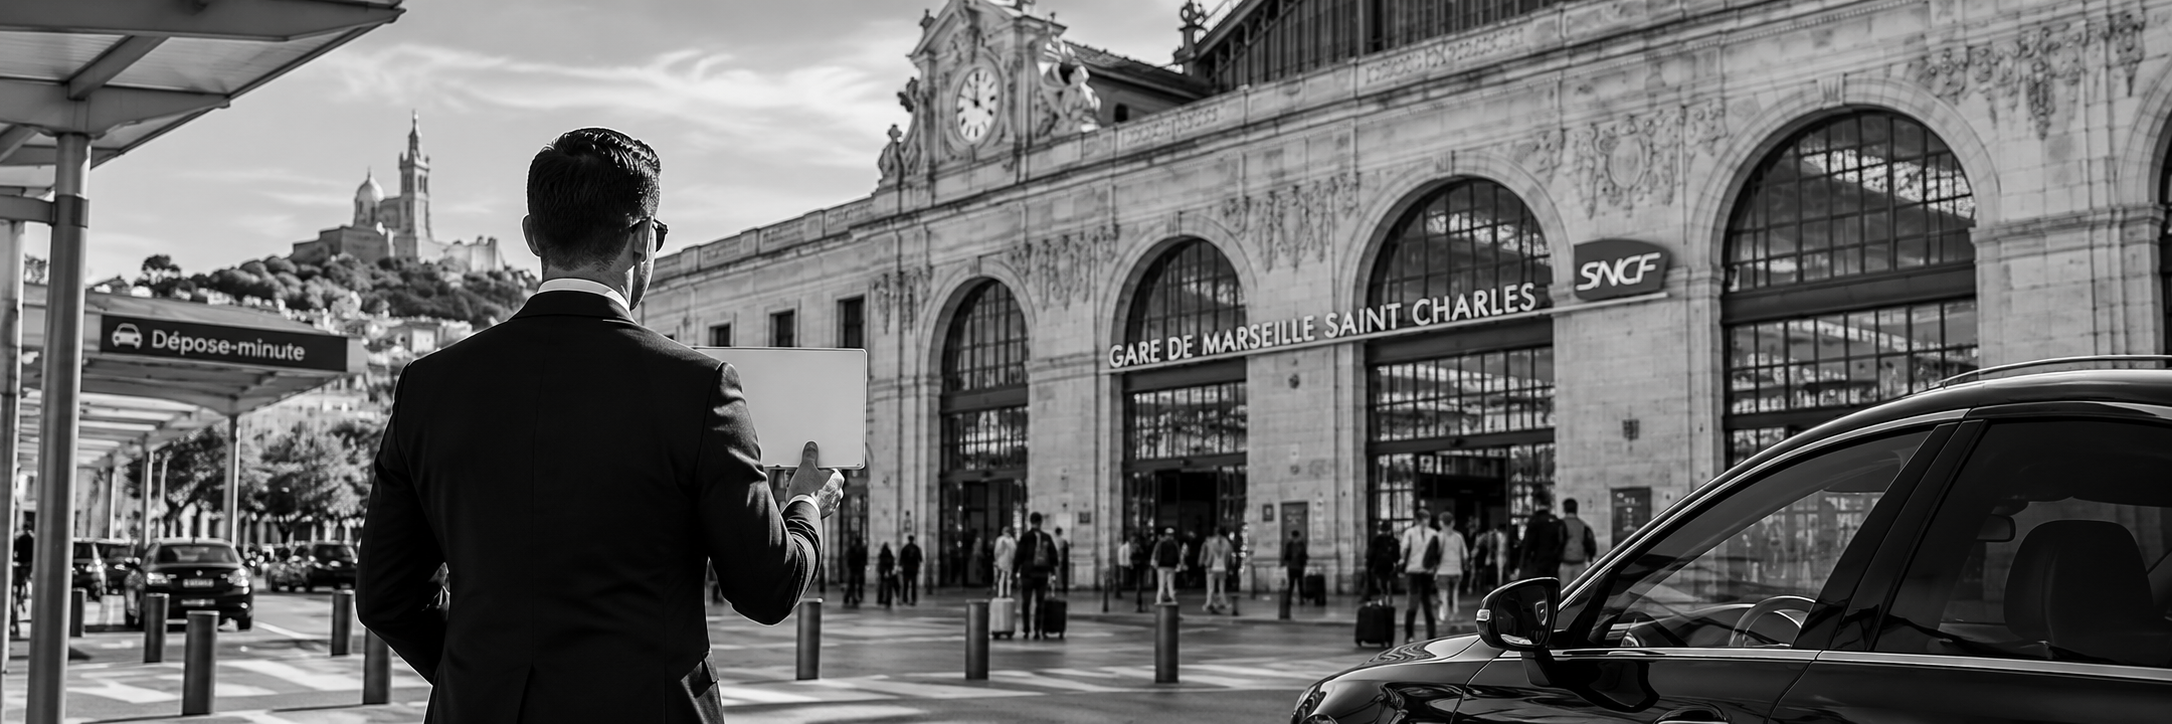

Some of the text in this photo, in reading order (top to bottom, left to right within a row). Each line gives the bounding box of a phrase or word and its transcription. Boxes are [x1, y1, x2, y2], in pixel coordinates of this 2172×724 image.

[1576, 252, 1661, 291] SNCF
[1109, 282, 1536, 367] GARE DE MARSEILLE SAINT CHARLES
[152, 329, 305, 361] Dépose-minute
